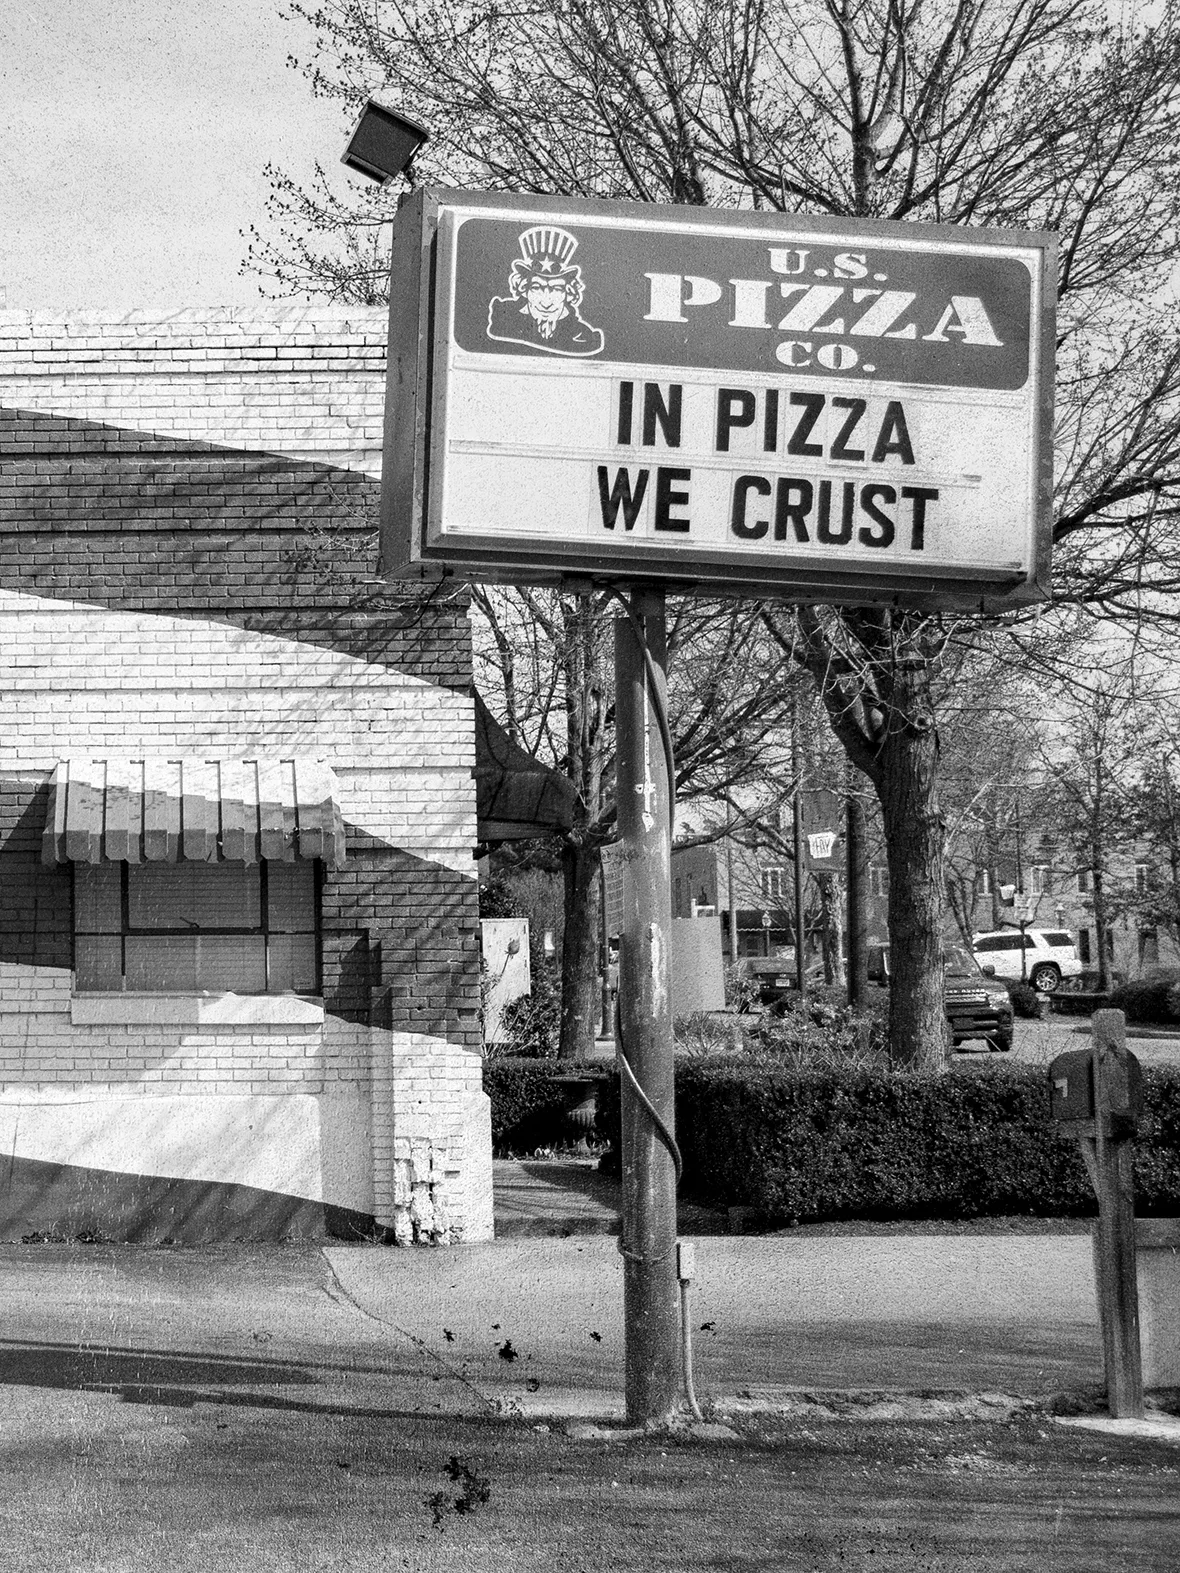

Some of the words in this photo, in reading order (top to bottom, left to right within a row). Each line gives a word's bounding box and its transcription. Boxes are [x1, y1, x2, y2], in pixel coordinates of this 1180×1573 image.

[767, 247, 888, 281] U.S.
[643, 272, 1004, 347] PIZZA
[775, 340, 876, 372] CO.
[617, 380, 683, 448] IN
[715, 387, 916, 465] PIZZA
[596, 465, 691, 532] WE
[731, 474, 939, 550] CRUST
